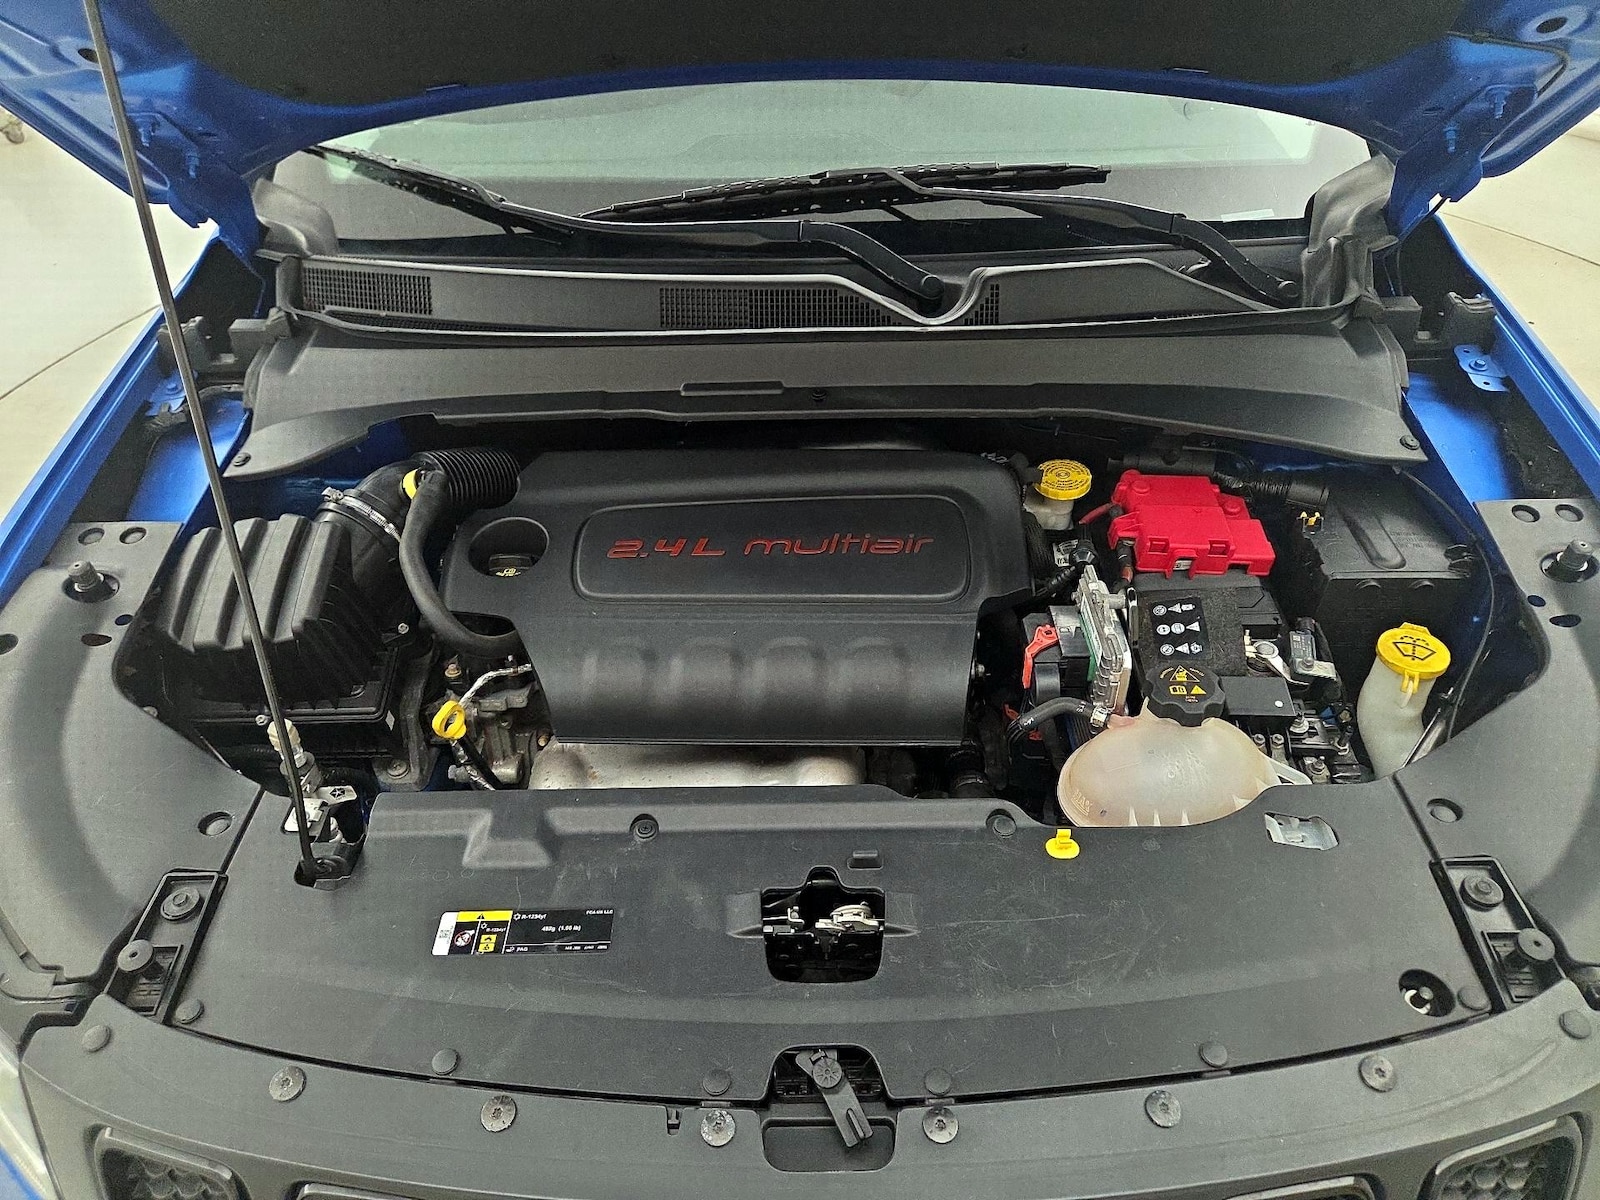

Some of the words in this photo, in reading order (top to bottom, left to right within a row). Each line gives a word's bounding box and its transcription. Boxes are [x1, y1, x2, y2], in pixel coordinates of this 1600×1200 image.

[607, 537, 726, 558] 2.4L
[744, 532, 935, 556] multiair
[521, 913, 547, 921] R-1234yf
